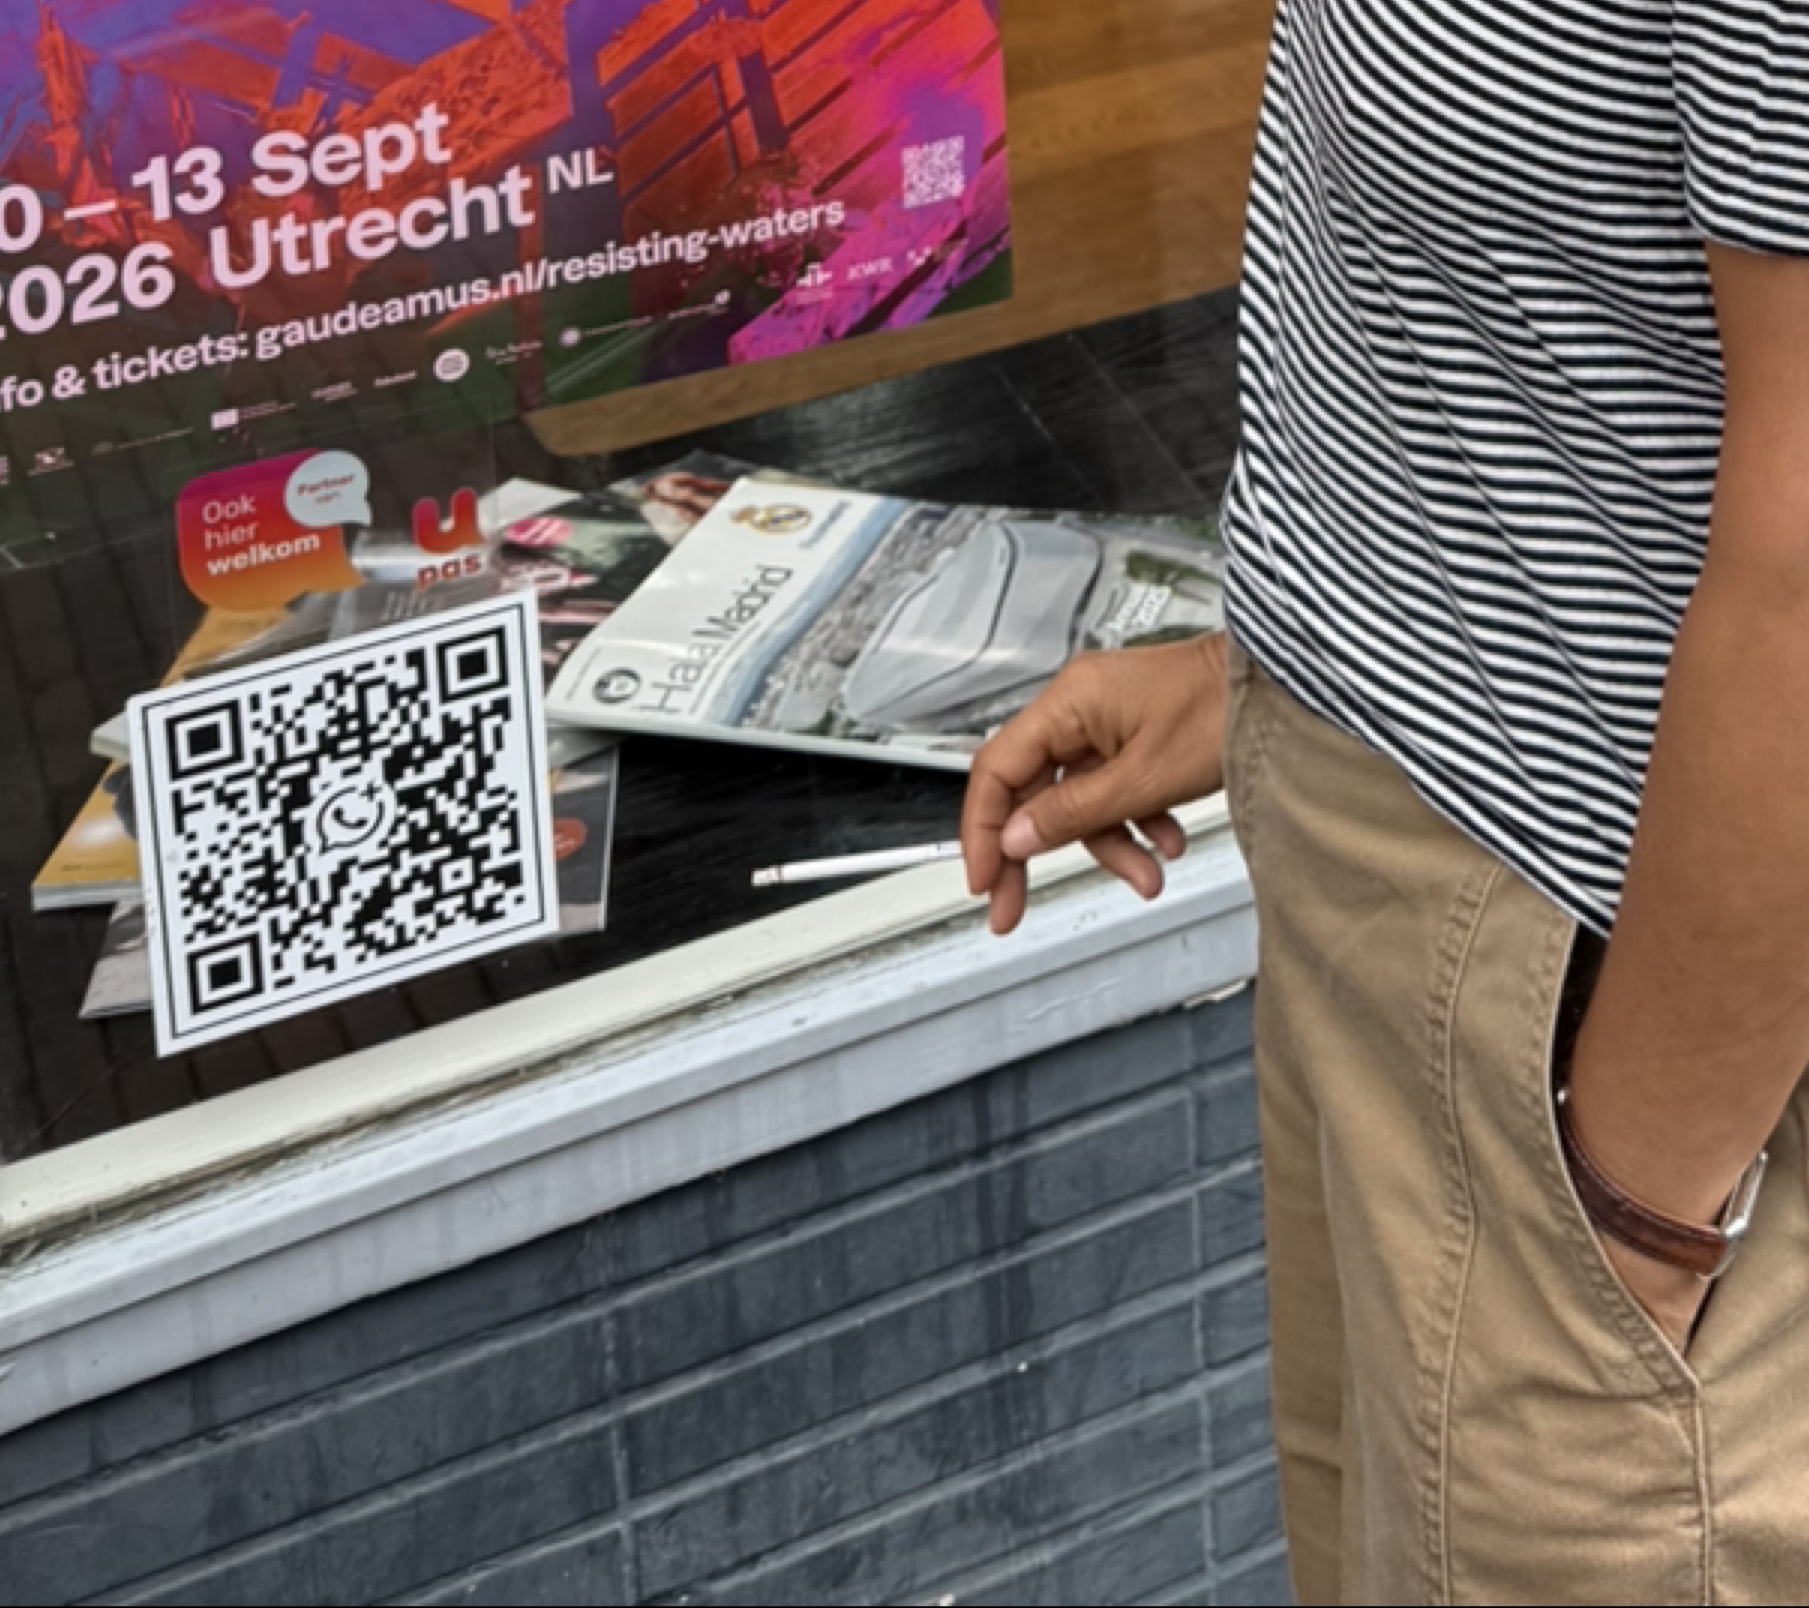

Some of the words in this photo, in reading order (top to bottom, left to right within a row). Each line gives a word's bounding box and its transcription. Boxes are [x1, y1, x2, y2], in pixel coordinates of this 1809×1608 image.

[131, 146, 224, 221] 13
[251, 100, 453, 197] Sept
[0, 241, 175, 340] 026
[210, 165, 535, 287] Utrecht
[547, 147, 613, 195] NL
[51, 364, 88, 400] &
[91, 330, 250, 390] tickets:
[254, 199, 846, 361] gaudeamus.nl/resisting-waters
[201, 493, 257, 525] Ook
[205, 520, 259, 552] hier
[205, 533, 321, 578] welkom
[416, 551, 483, 592] pas
[690, 562, 795, 640] Madrid
